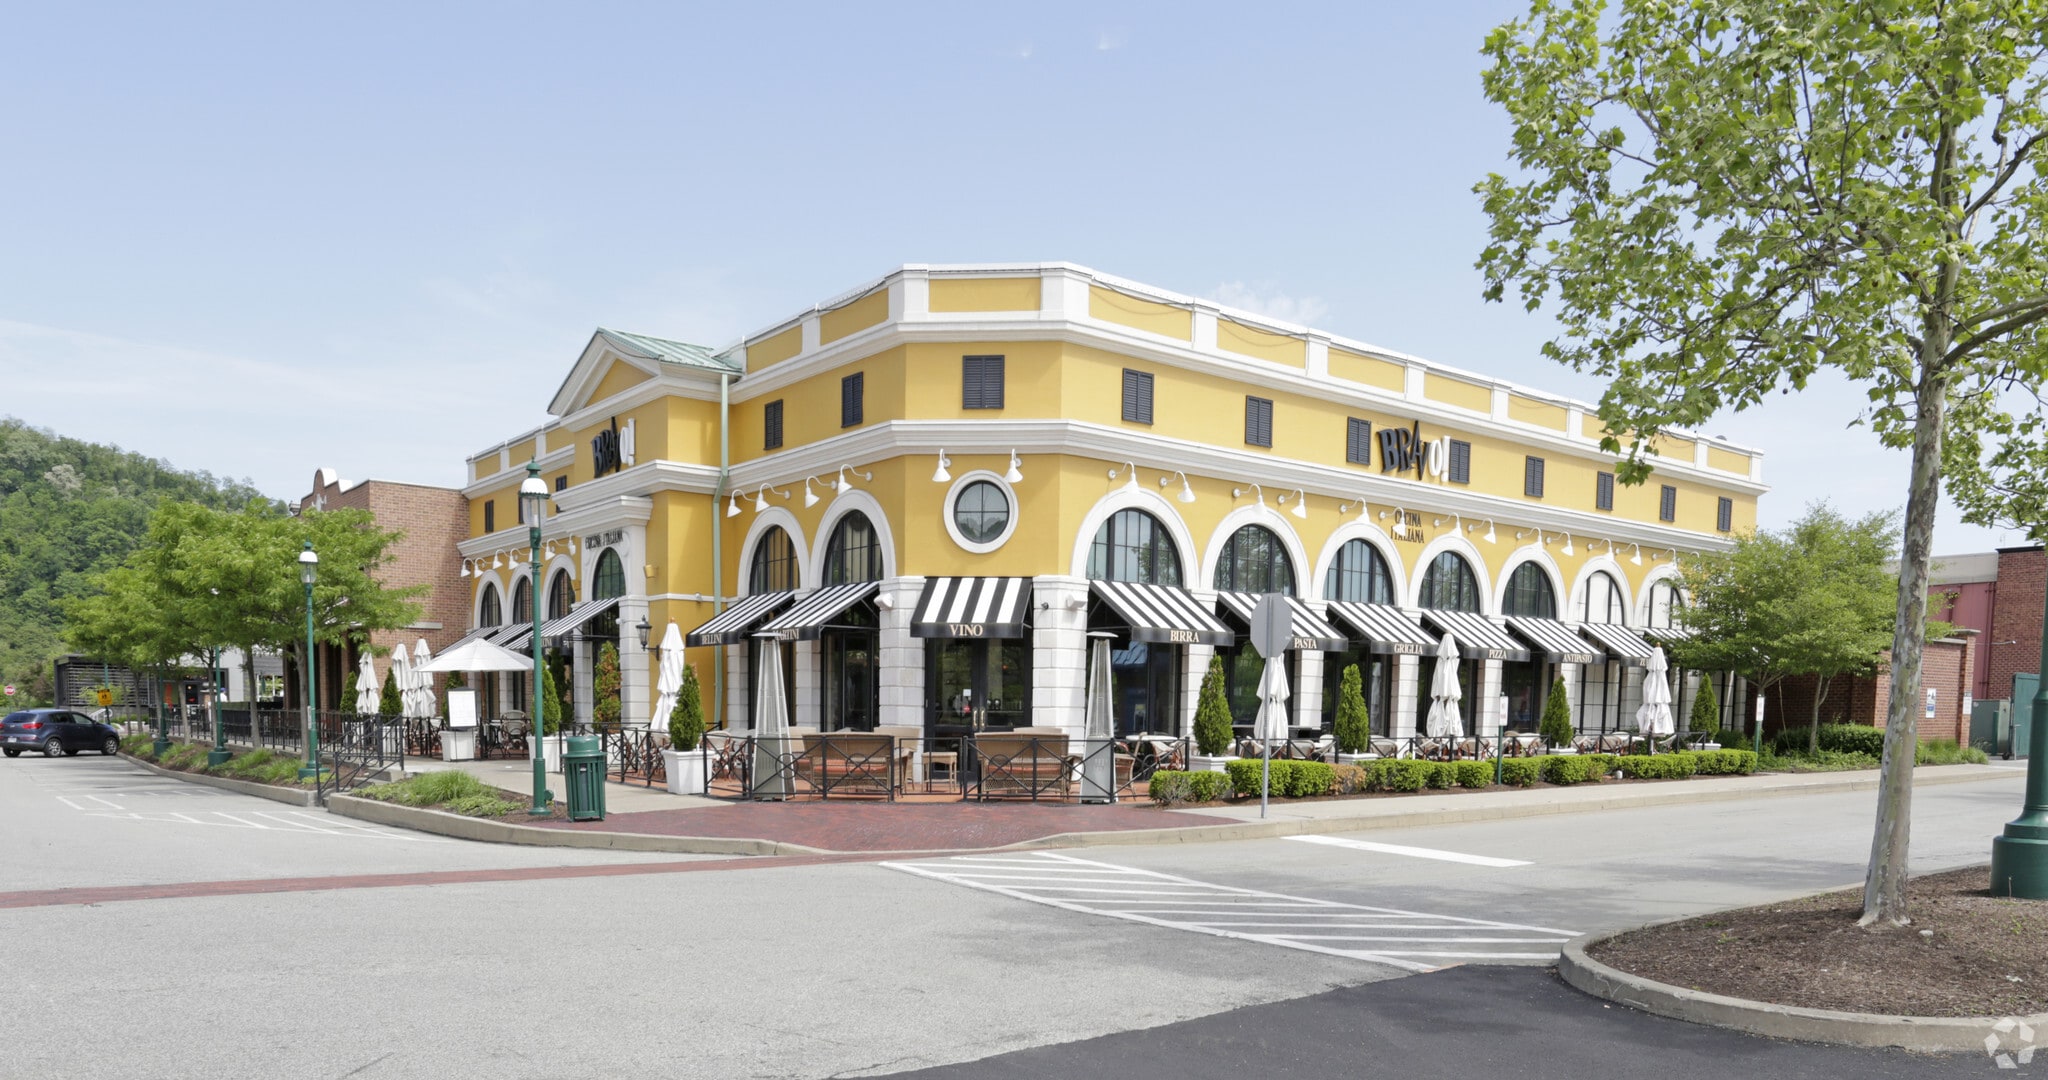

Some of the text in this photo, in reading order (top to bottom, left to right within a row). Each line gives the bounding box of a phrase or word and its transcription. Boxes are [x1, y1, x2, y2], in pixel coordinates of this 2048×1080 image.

[591, 416, 635, 478] BRAVO!
[1376, 420, 1451, 482] BRAVO!
[1390, 526, 1424, 543] IIANA
[949, 624, 984, 637] VINO
[1170, 630, 1200, 643] BIRRA
[702, 633, 721, 645] BELLINI
[1294, 637, 1318, 649] PASTA
[1394, 643, 1423, 655] GRIGLIA
[1489, 649, 1507, 660] PIZZA
[1562, 653, 1593, 664] ANTIPASTO
